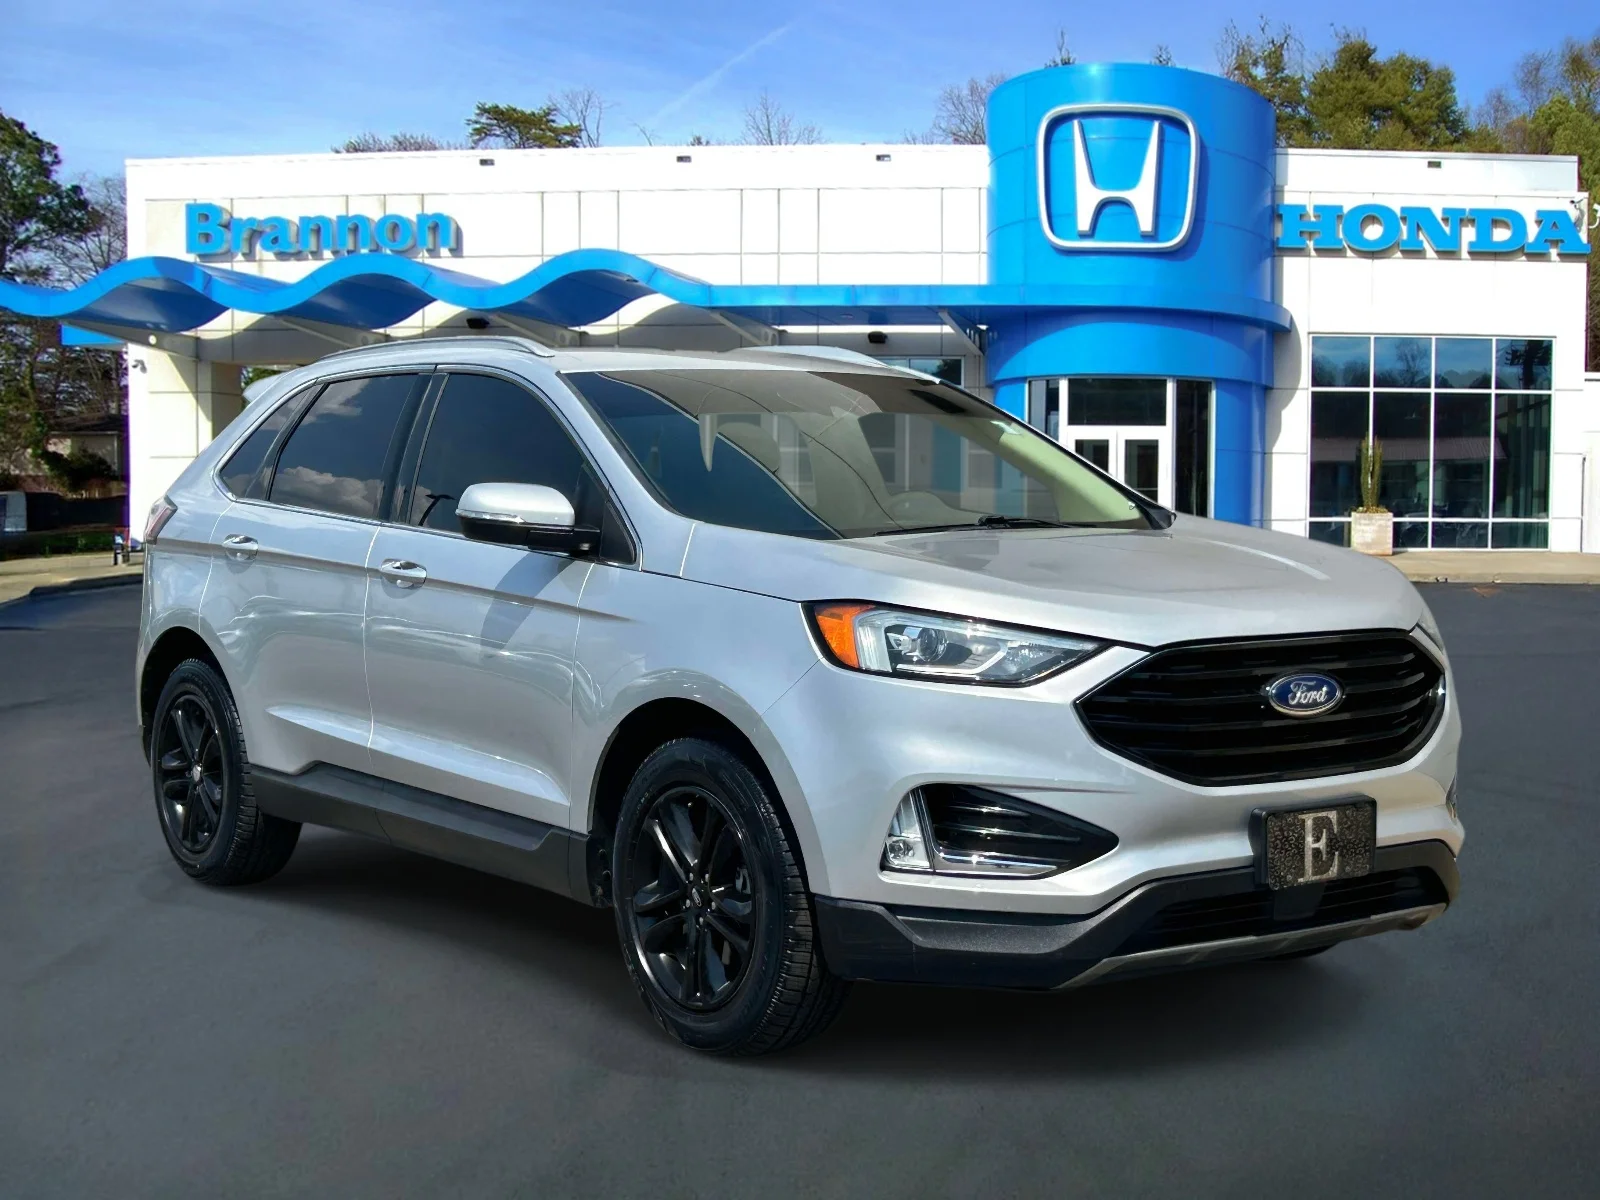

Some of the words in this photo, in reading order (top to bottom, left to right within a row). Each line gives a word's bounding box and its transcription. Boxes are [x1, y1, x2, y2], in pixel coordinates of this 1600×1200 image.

[186, 203, 457, 255] Brannon
[1276, 203, 1591, 254] HONDA
[1287, 681, 1328, 705] Ford
[1298, 810, 1339, 884] E
